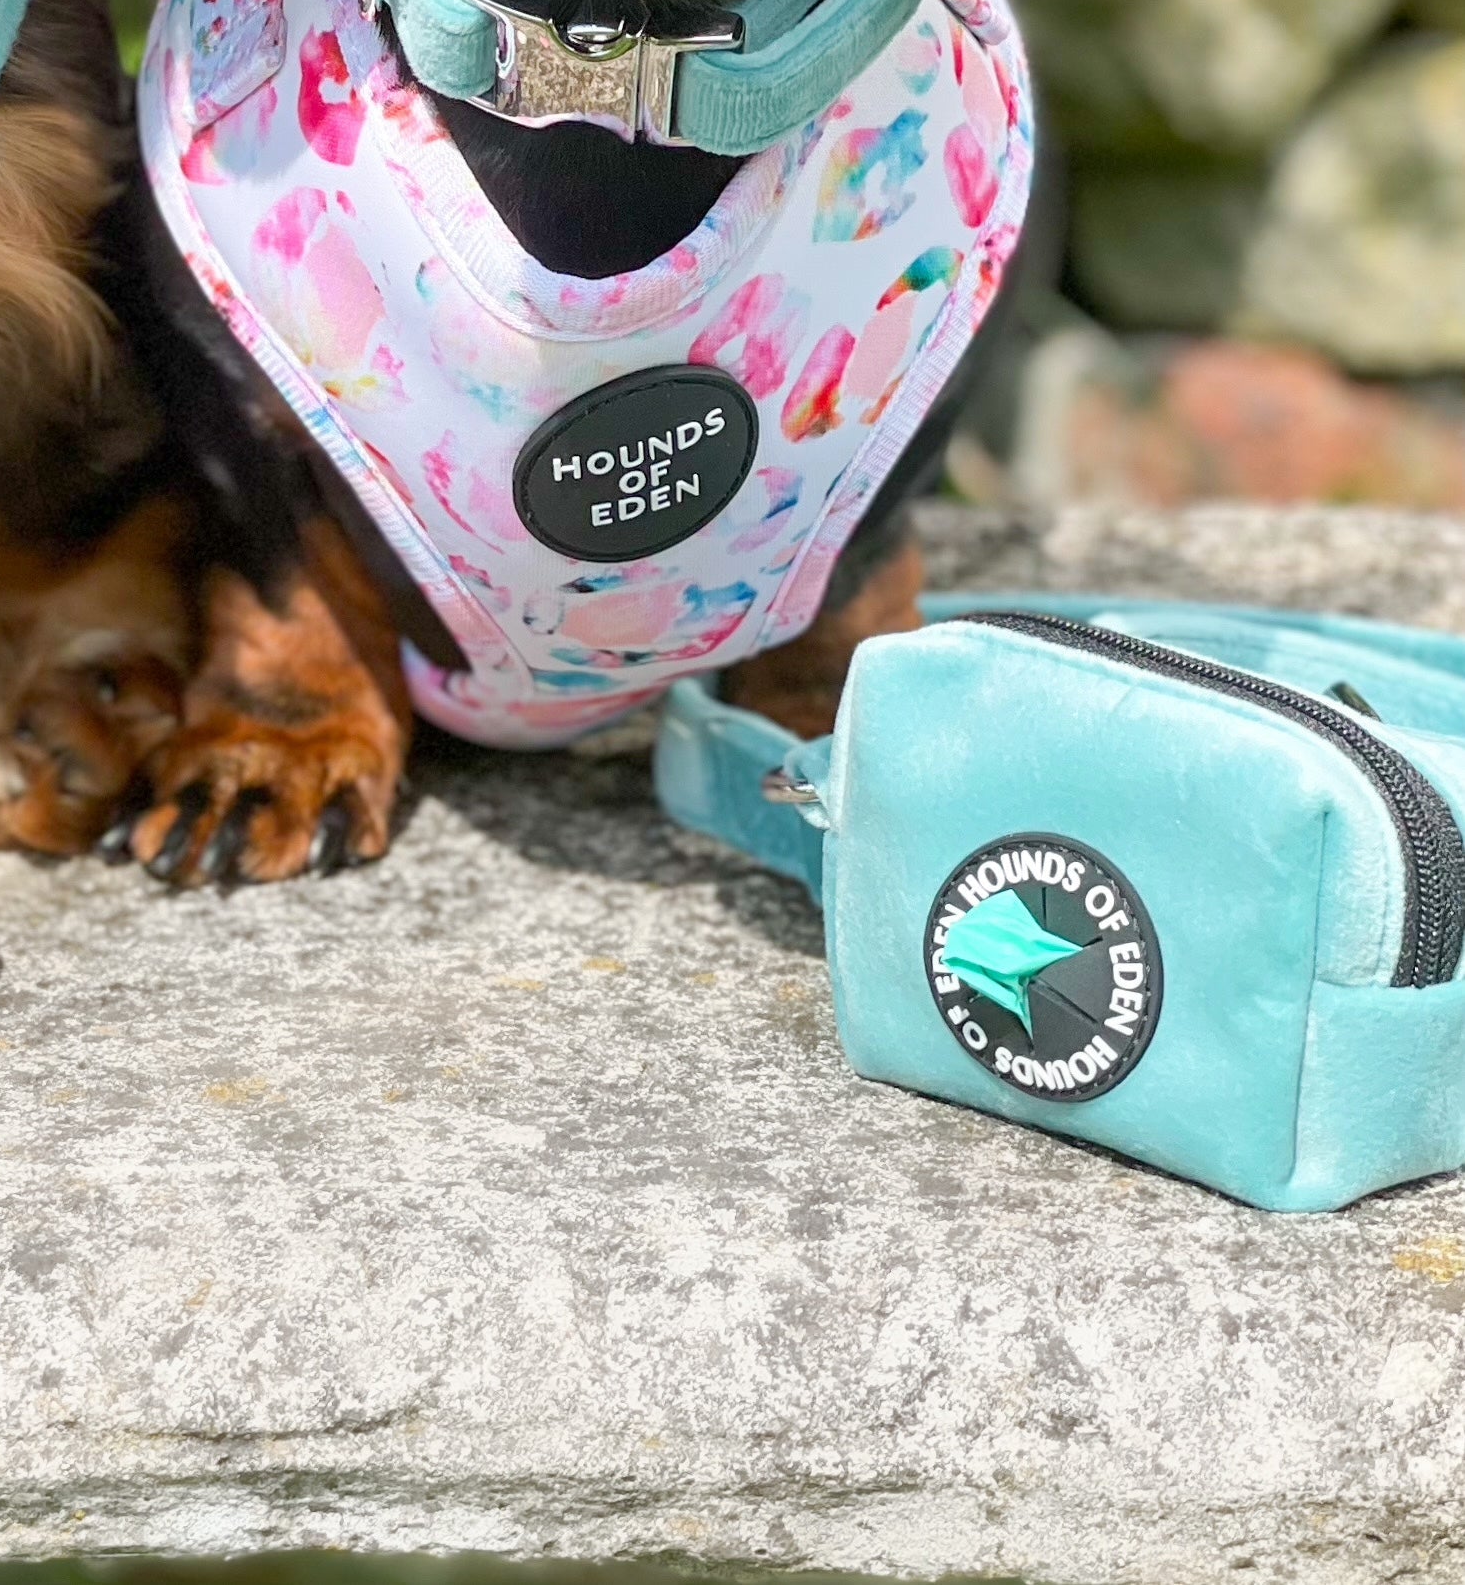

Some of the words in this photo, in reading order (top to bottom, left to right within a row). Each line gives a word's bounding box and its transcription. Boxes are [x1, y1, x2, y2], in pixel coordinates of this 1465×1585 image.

[552, 407, 726, 482] HOUNDS
[590, 473, 700, 527] EDEN
[618, 460, 671, 494] OF
[957, 850, 1086, 908] HOUNDS
[1085, 885, 1130, 932] OF
[1104, 941, 1144, 1036] EDEN
[947, 1004, 988, 1051] OF
[994, 1034, 1118, 1090] HOUNDS
